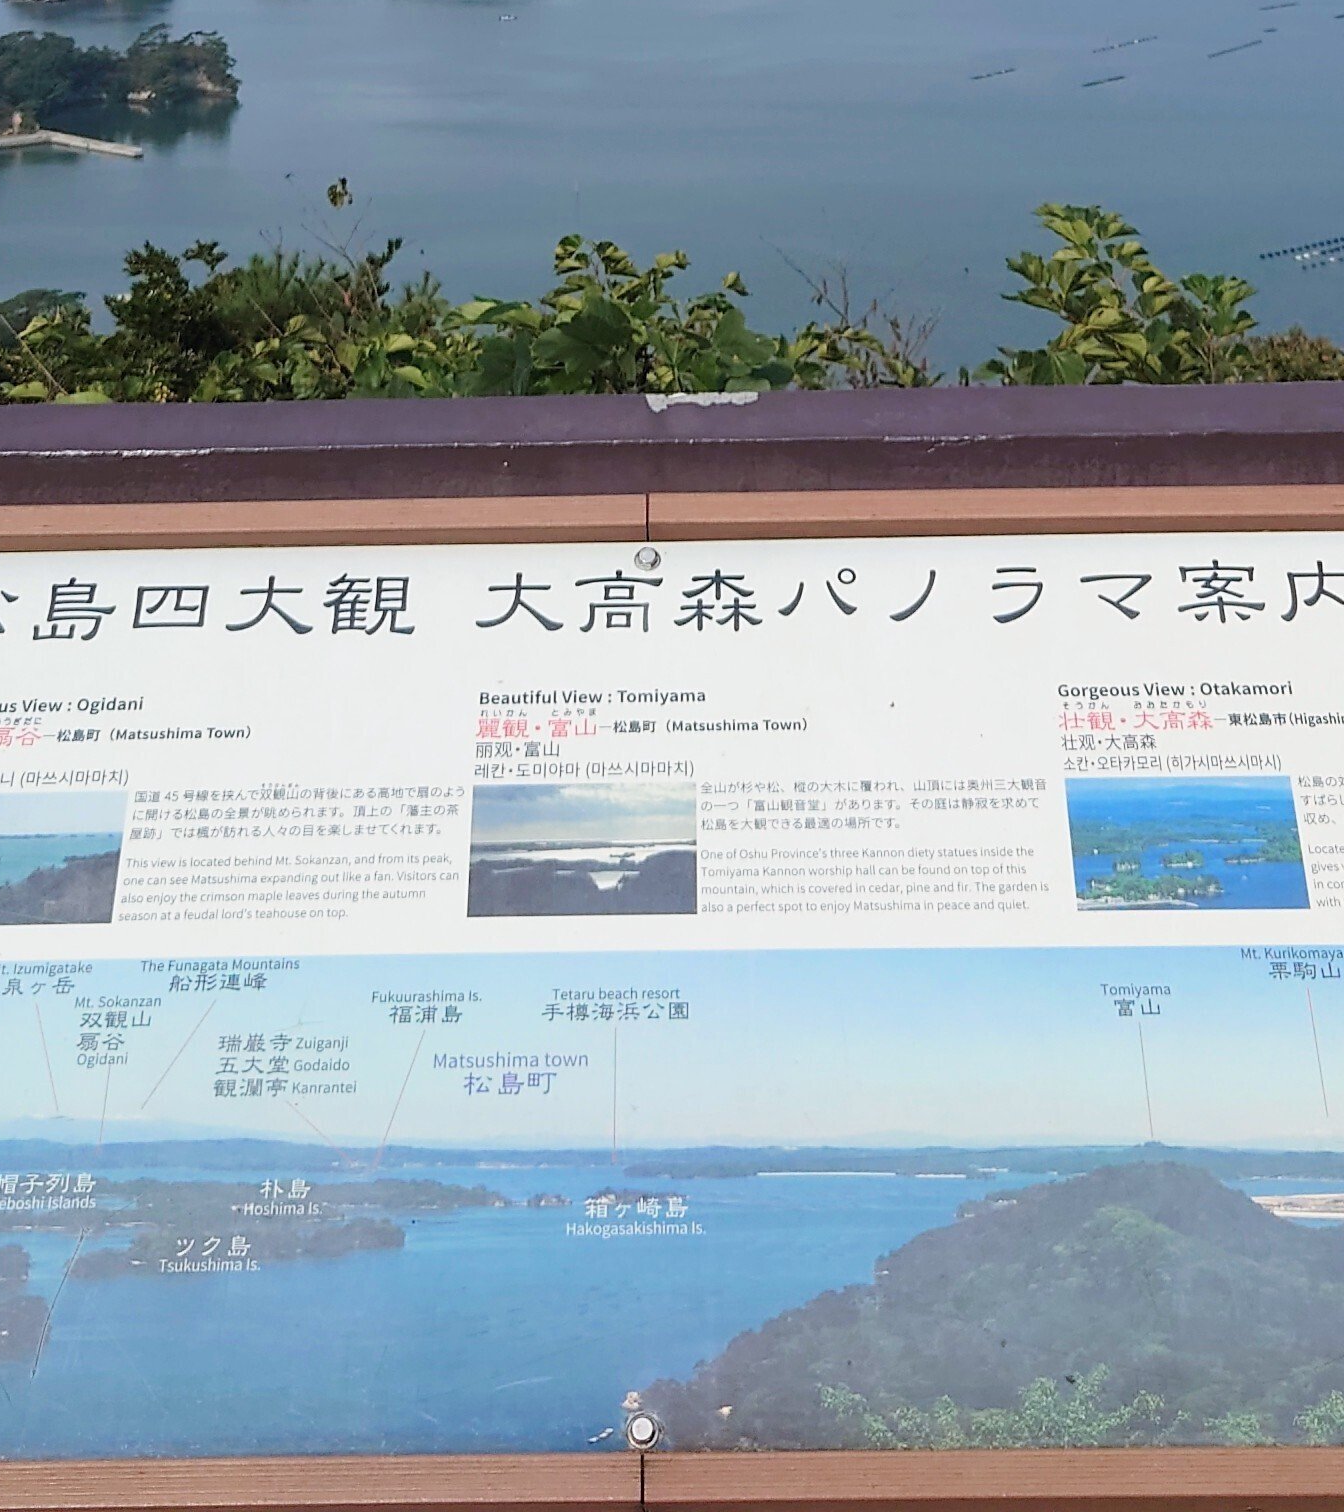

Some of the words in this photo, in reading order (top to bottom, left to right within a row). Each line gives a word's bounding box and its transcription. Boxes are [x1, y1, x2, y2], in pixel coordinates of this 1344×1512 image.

[478, 689, 557, 705] Beautiful
[561, 689, 603, 704] View
[616, 687, 706, 706] Tomiyama
[1057, 683, 1140, 701] Gorgeous
[1142, 681, 1185, 696] View
[1199, 680, 1293, 696] Otakamori
[21, 697, 63, 713] View
[76, 695, 144, 715] Ogidani
[1240, 947, 1261, 960] Mt.
[12, 959, 93, 978] Izumigatake
[139, 958, 165, 973] The
[167, 958, 228, 975] Funagata
[230, 956, 300, 975] Mountains
[370, 988, 465, 1004] Fukuurashima
[467, 988, 482, 1002] Is.
[551, 987, 595, 1001] Tetaru
[597, 986, 638, 1000] beach
[640, 987, 680, 1000] resort
[1099, 982, 1171, 999] Tomiyama
[74, 996, 94, 1009] Mt.
[98, 995, 162, 1008] Sokanzan
[295, 1035, 349, 1053] Zuiganji
[76, 1052, 128, 1069] Ogidani
[293, 1058, 350, 1072] Godaido
[432, 1050, 539, 1069] Matsushima
[543, 1051, 588, 1068] town
[291, 1080, 357, 1095] Kanrantei
[46, 1194, 96, 1210] Islands
[243, 1200, 304, 1215] Hoshima
[307, 1201, 327, 1214] Is.
[565, 1220, 688, 1239] Hakogasakishima
[691, 1220, 706, 1235] Is.
[158, 1257, 242, 1272] Tsukushima
[245, 1257, 260, 1271] Is.
